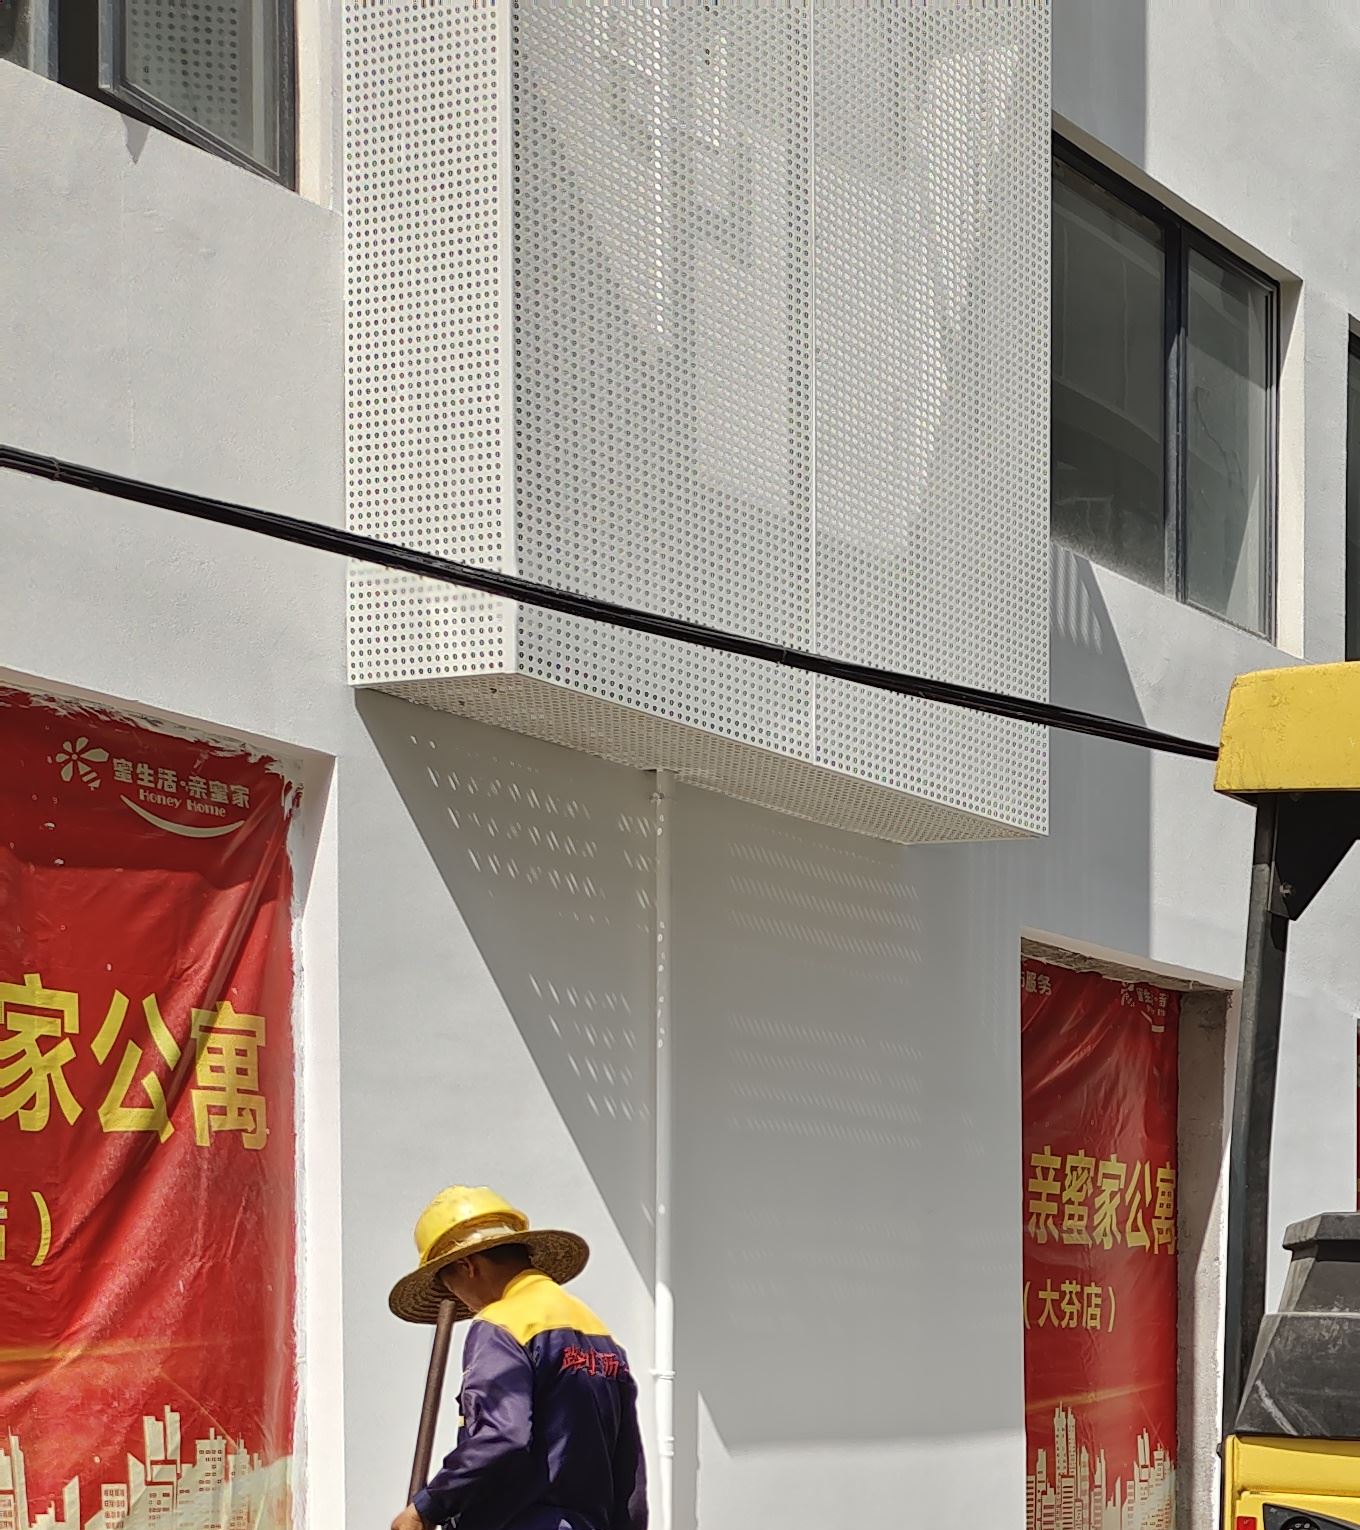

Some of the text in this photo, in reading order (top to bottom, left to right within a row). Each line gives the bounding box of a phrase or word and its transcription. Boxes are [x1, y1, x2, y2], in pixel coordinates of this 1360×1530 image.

[139, 788, 226, 817] Honey Home
[0, 973, 266, 1150] 家公寓
[1028, 1145, 1176, 1255] 亲蜜家公寓
[1024, 1279, 1116, 1332] （大芬店）
